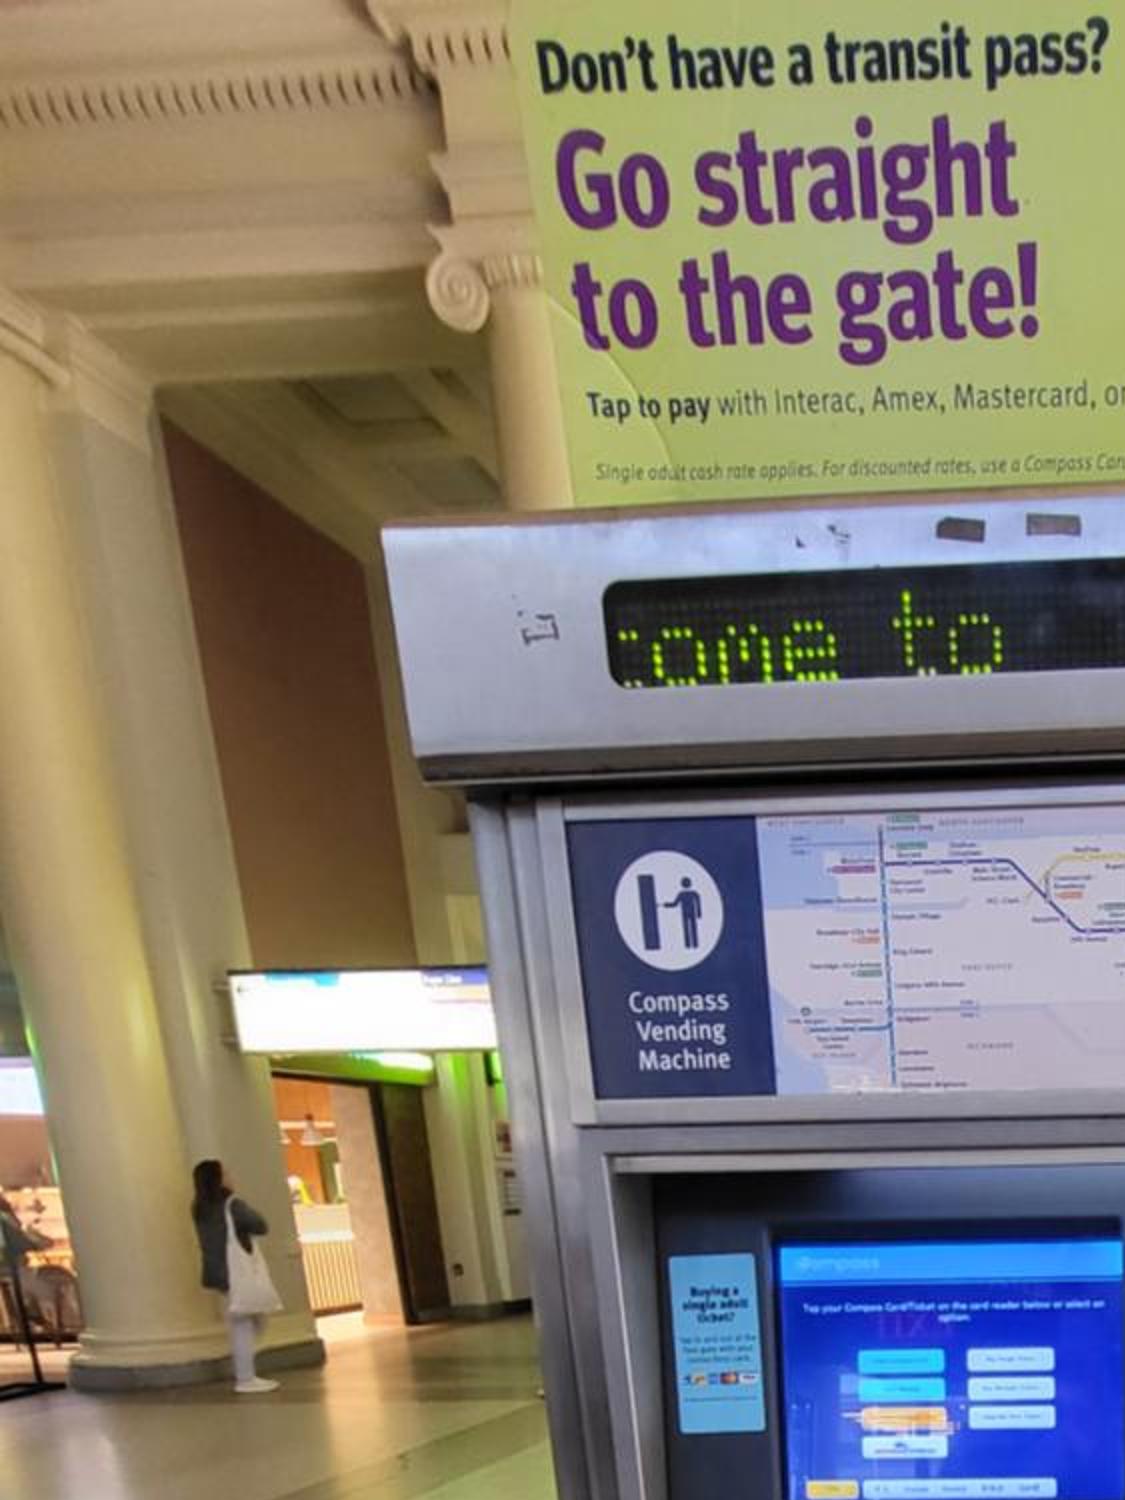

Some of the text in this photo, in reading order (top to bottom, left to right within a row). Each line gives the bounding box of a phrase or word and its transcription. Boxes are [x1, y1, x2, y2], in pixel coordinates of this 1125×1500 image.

[536, 16, 1110, 95] Don't have a transit pass?
[555, 114, 1020, 244] Go straight
[572, 241, 1039, 366] to the gate!
[587, 392, 632, 424] Tap
[637, 394, 664, 420] to
[668, 395, 711, 425] pay
[716, 386, 769, 417] with
[774, 383, 865, 417] Interac,
[872, 385, 947, 414] Amex,
[953, 379, 1097, 414] Mastercard,
[596, 463, 643, 485] Single
[647, 462, 686, 481] adult
[689, 461, 722, 481] cash
[726, 463, 757, 480] rate
[760, 460, 817, 482] applies.
[821, 459, 846, 477] For
[849, 457, 931, 477] discounted
[981, 460, 1007, 475] use
[1010, 460, 1021, 473] a
[1024, 454, 1092, 475] Compass
[892, 590, 1003, 676] to
[628, 991, 730, 1016] Compass
[636, 1020, 726, 1044] Vending
[639, 1050, 731, 1071] Machine
